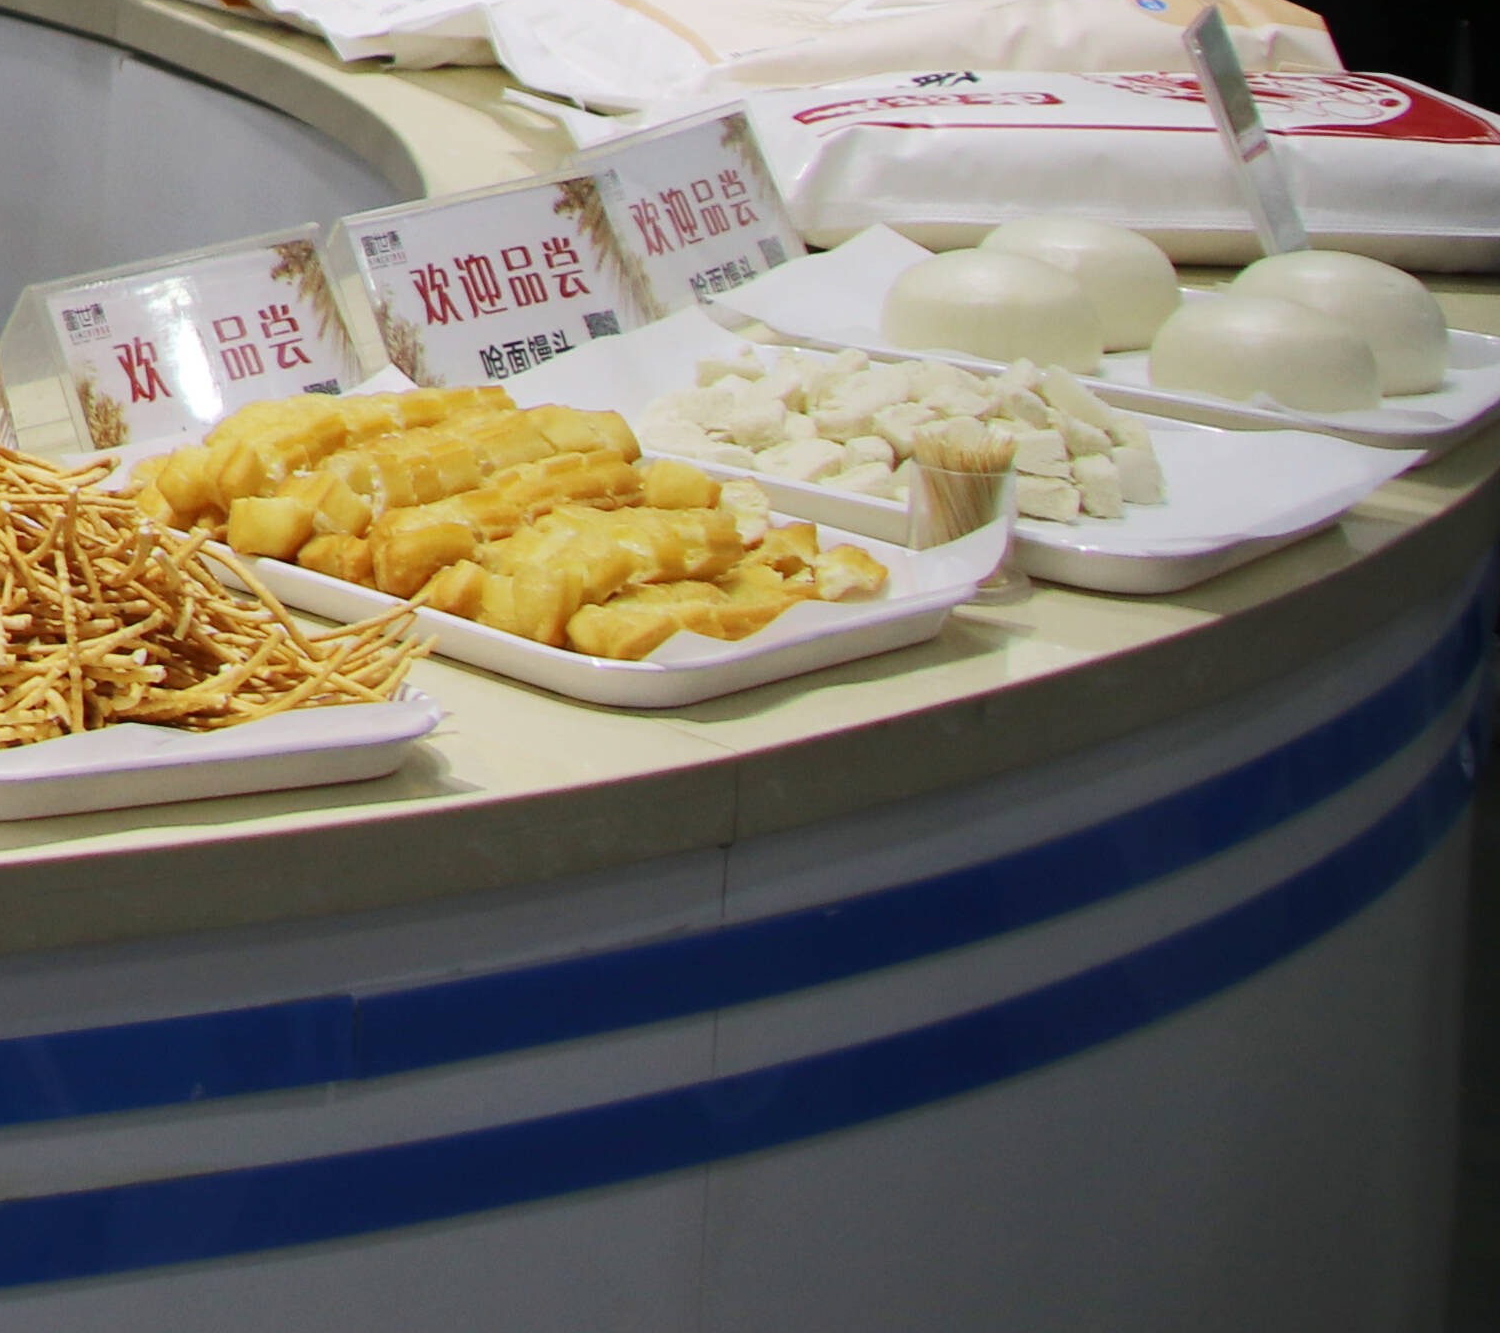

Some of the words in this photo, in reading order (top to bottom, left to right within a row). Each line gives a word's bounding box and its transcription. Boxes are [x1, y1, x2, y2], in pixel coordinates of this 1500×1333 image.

[628, 169, 760, 257] 欢迎品尝
[409, 236, 591, 326] 欢迎品尝
[112, 303, 313, 404] 欢品尝
